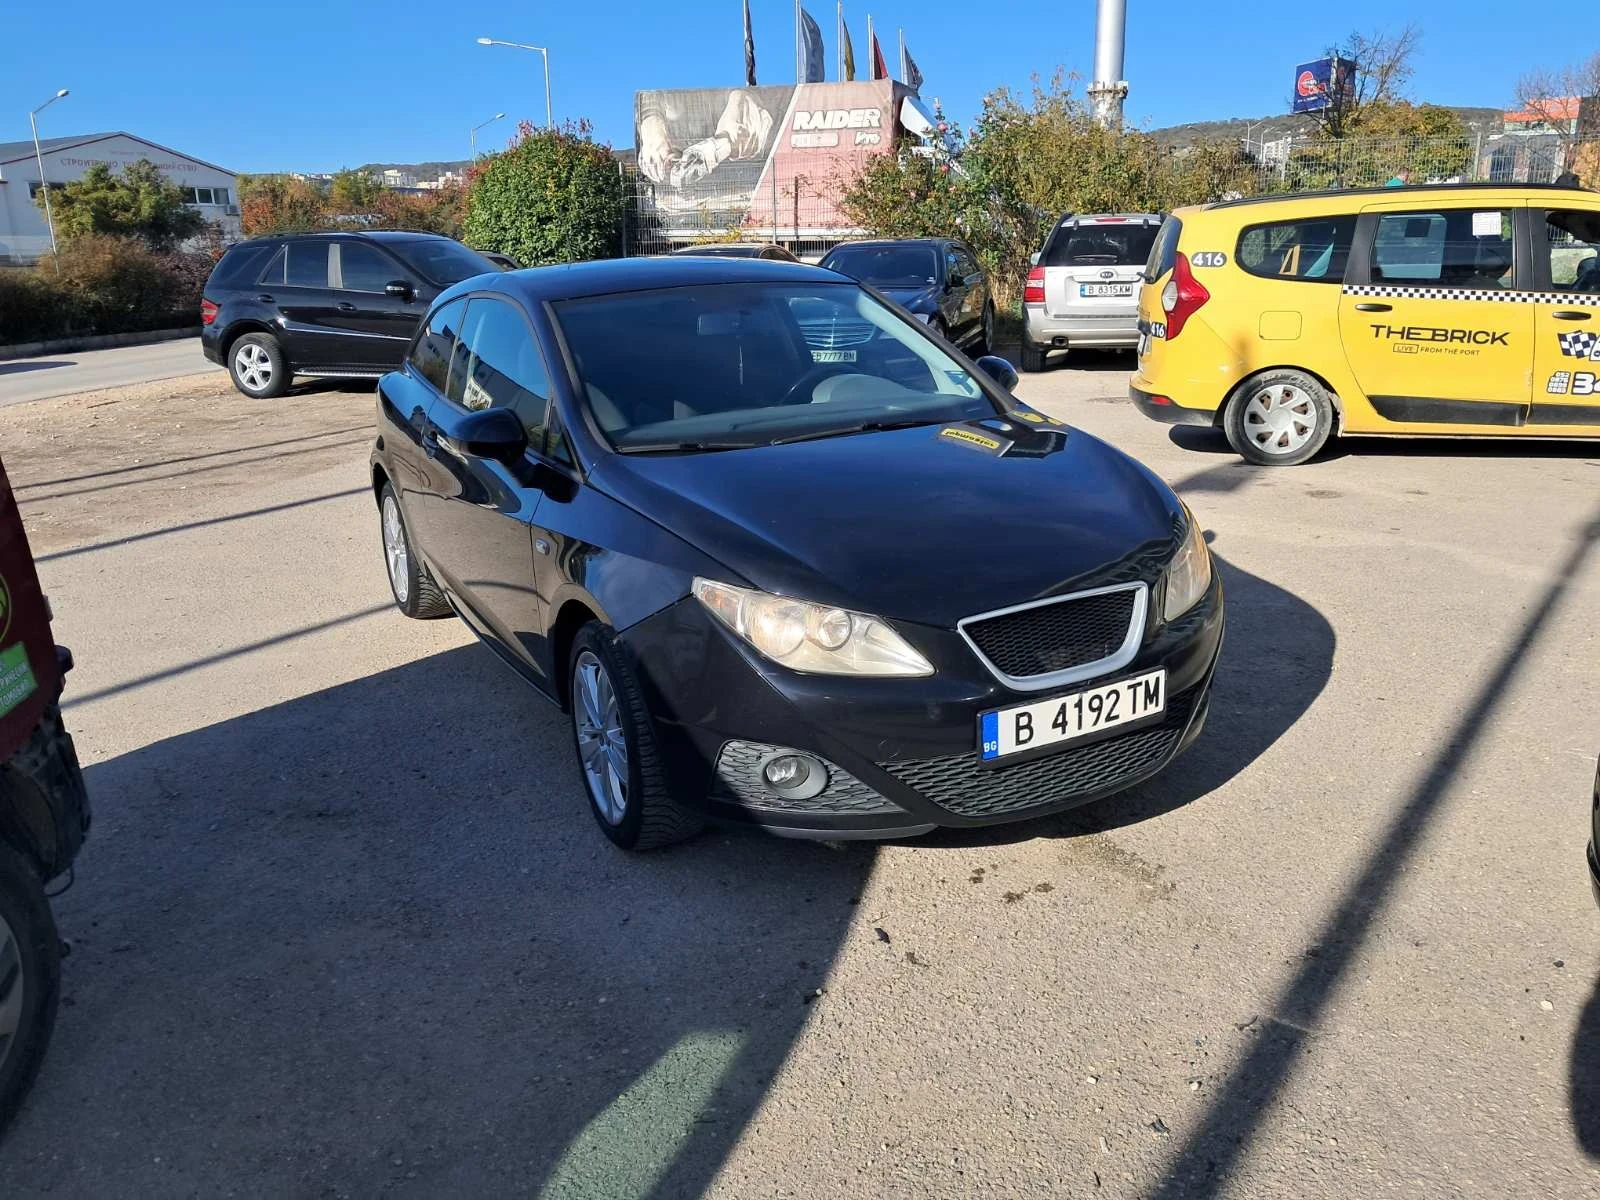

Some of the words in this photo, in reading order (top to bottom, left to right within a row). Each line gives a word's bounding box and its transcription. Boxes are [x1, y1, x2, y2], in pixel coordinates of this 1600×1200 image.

[793, 108, 880, 130] RAIDER
[1192, 252, 1225, 266] 416
[1100, 271, 1114, 279] KIA
[1088, 286, 1095, 294] B
[1119, 285, 1131, 294] KM
[1420, 346, 1443, 354] FROM
[1444, 347, 1459, 355] THE
[1015, 711, 1034, 746] B
[1051, 689, 1121, 735] 4192
[1127, 676, 1160, 715] TM
[983, 740, 997, 752] BG
